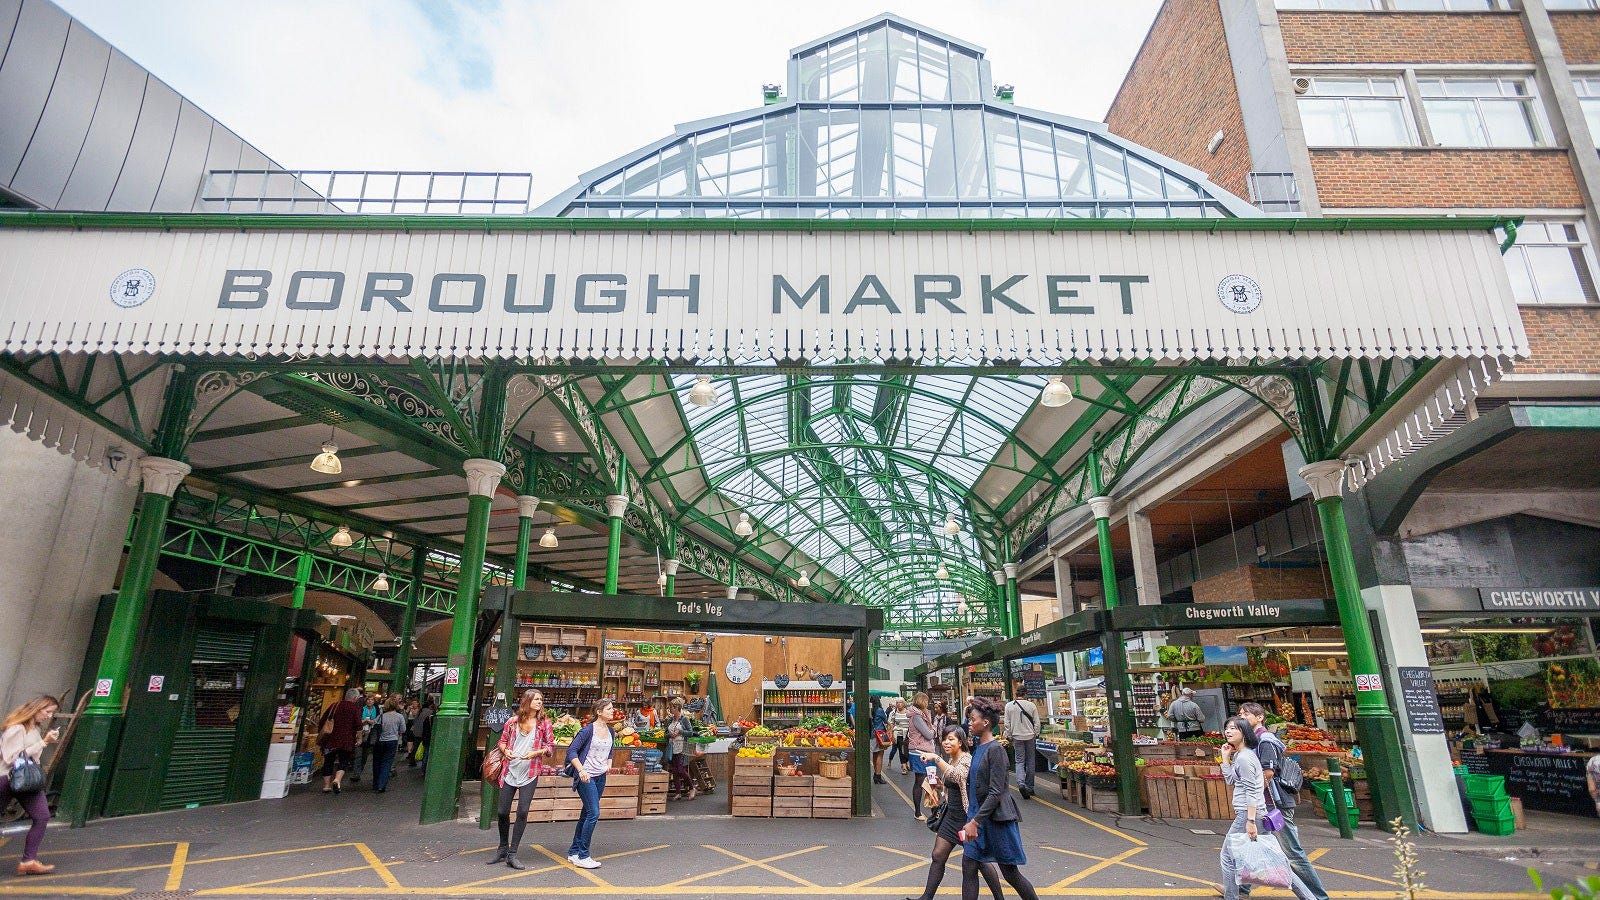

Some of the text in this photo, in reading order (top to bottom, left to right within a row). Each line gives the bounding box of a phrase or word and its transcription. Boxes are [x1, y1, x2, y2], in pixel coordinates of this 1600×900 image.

[217, 270, 1149, 315] BOROUGH MARKET
[1220, 275, 1240, 300] BOROUGH
[1490, 591, 1587, 607] CHEGWORTH
[676, 601, 723, 617] Ted's Veg
[1185, 604, 1280, 620] Chegworth Valley
[663, 644, 684, 656] VEG
